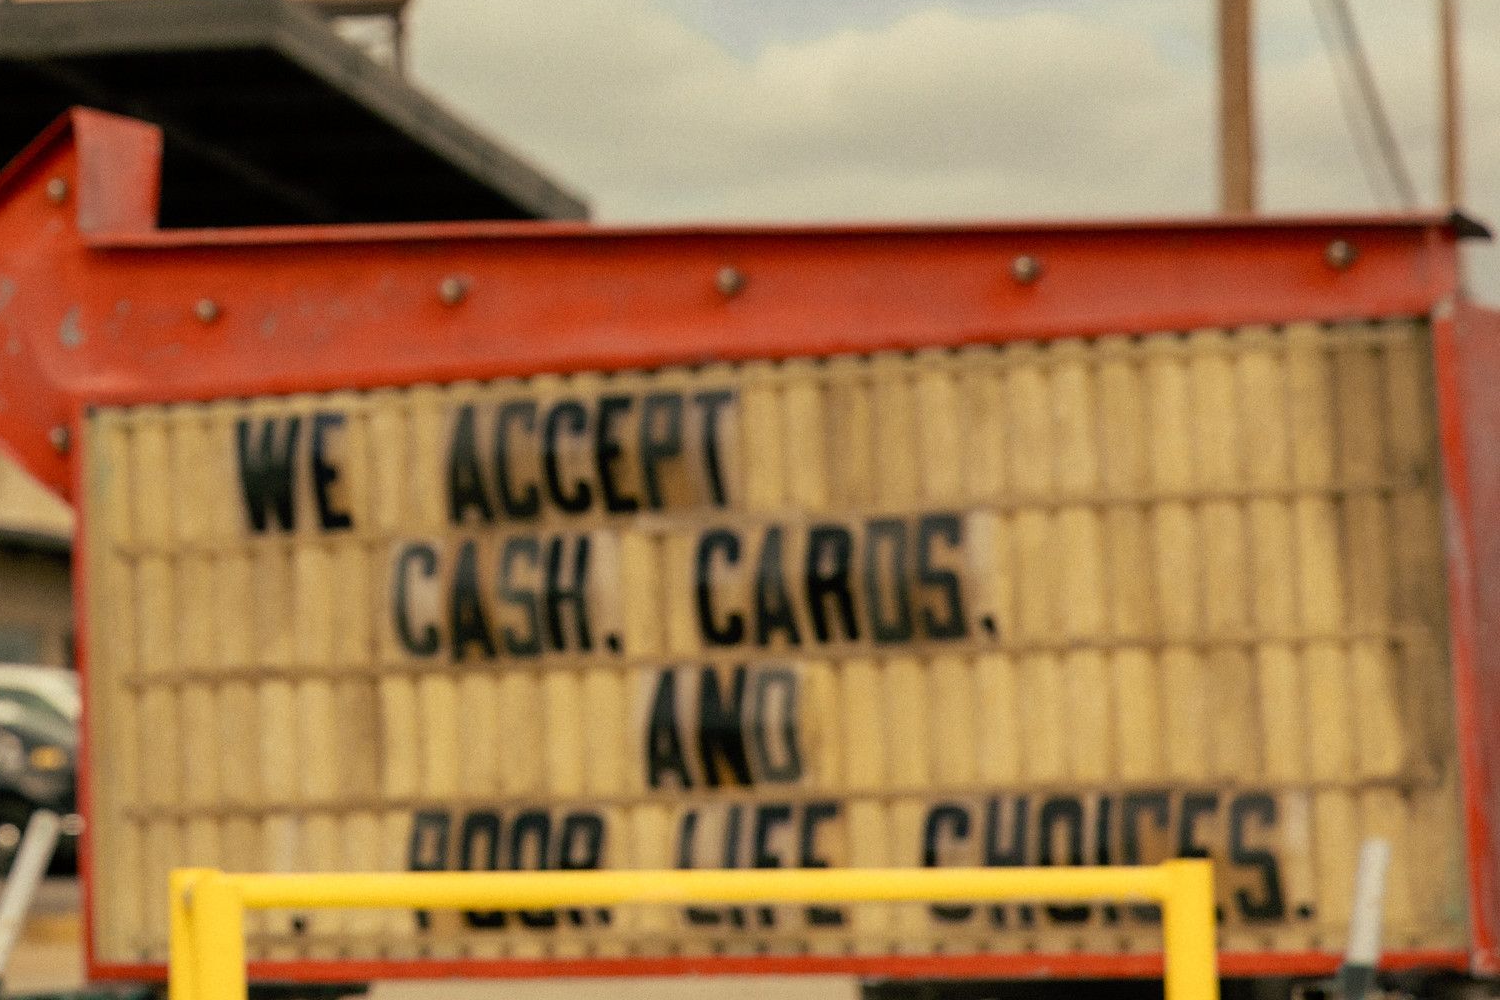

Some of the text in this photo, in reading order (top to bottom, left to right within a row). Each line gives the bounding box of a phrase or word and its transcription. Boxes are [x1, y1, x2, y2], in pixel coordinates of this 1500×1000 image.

[237, 390, 734, 533] WE ACCEPT
[645, 666, 804, 788] AND
